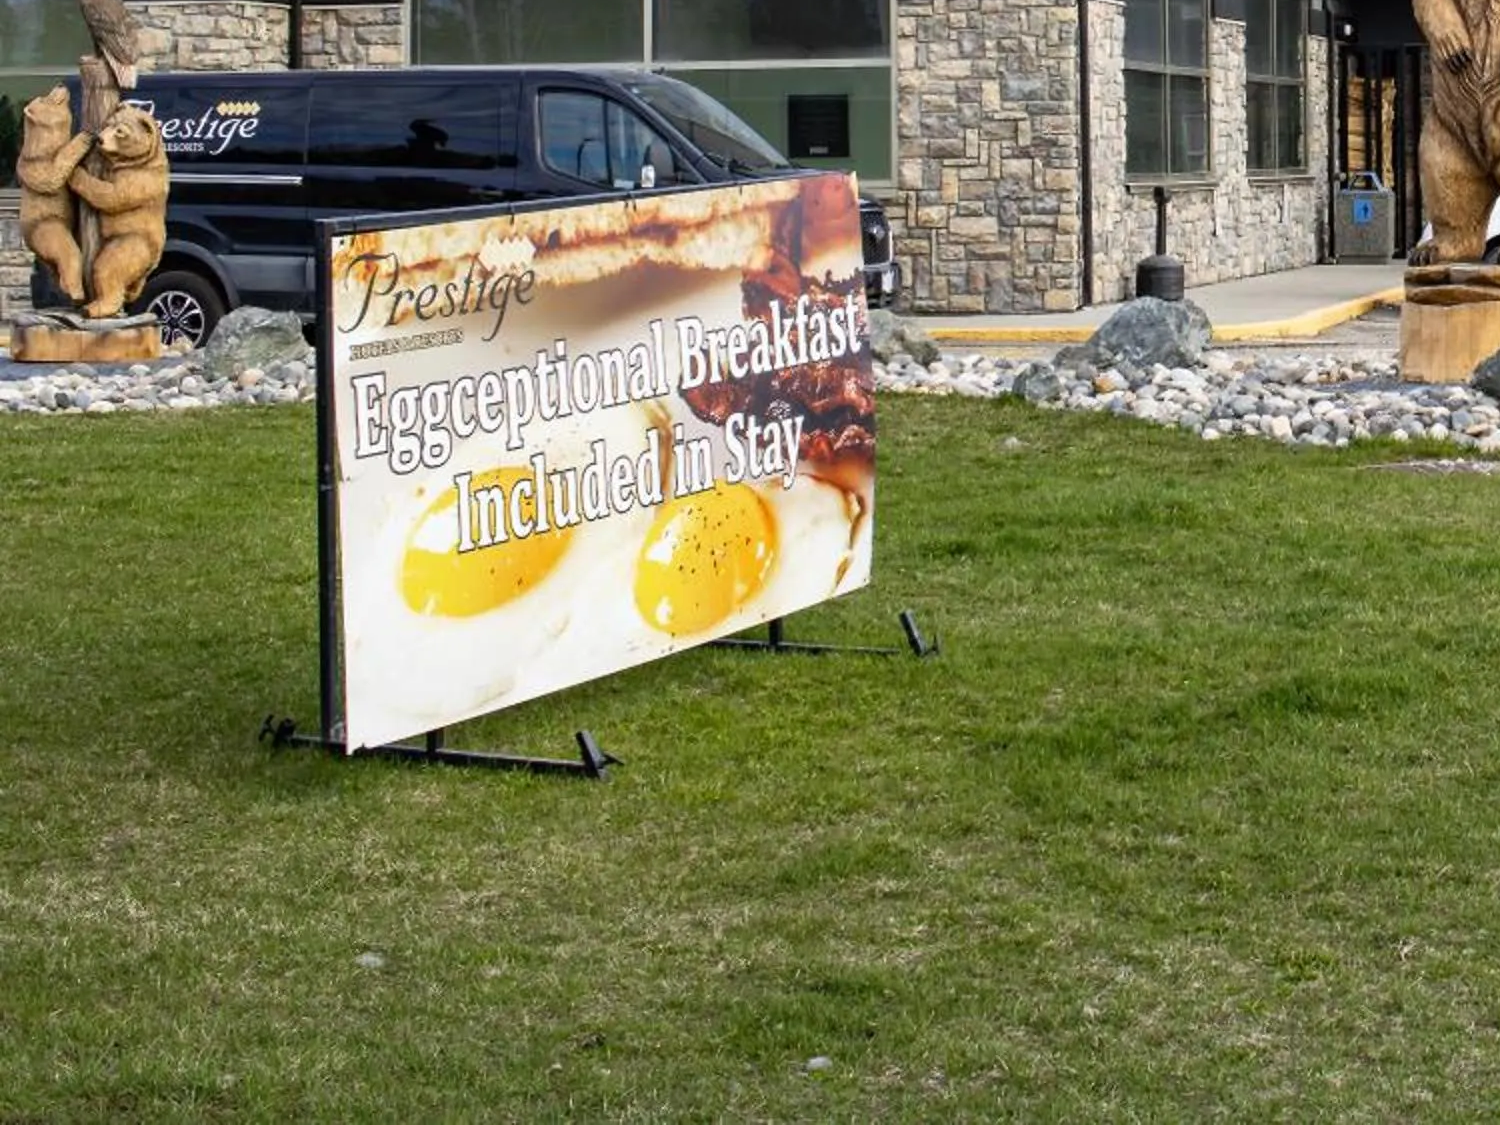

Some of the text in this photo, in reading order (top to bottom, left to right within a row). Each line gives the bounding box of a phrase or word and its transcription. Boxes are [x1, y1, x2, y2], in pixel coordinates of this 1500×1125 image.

[123, 99, 259, 155] estige
[338, 252, 536, 342] Prestige
[351, 292, 862, 474] Eggceptional Breakfast
[455, 411, 804, 554] Included in Stay
